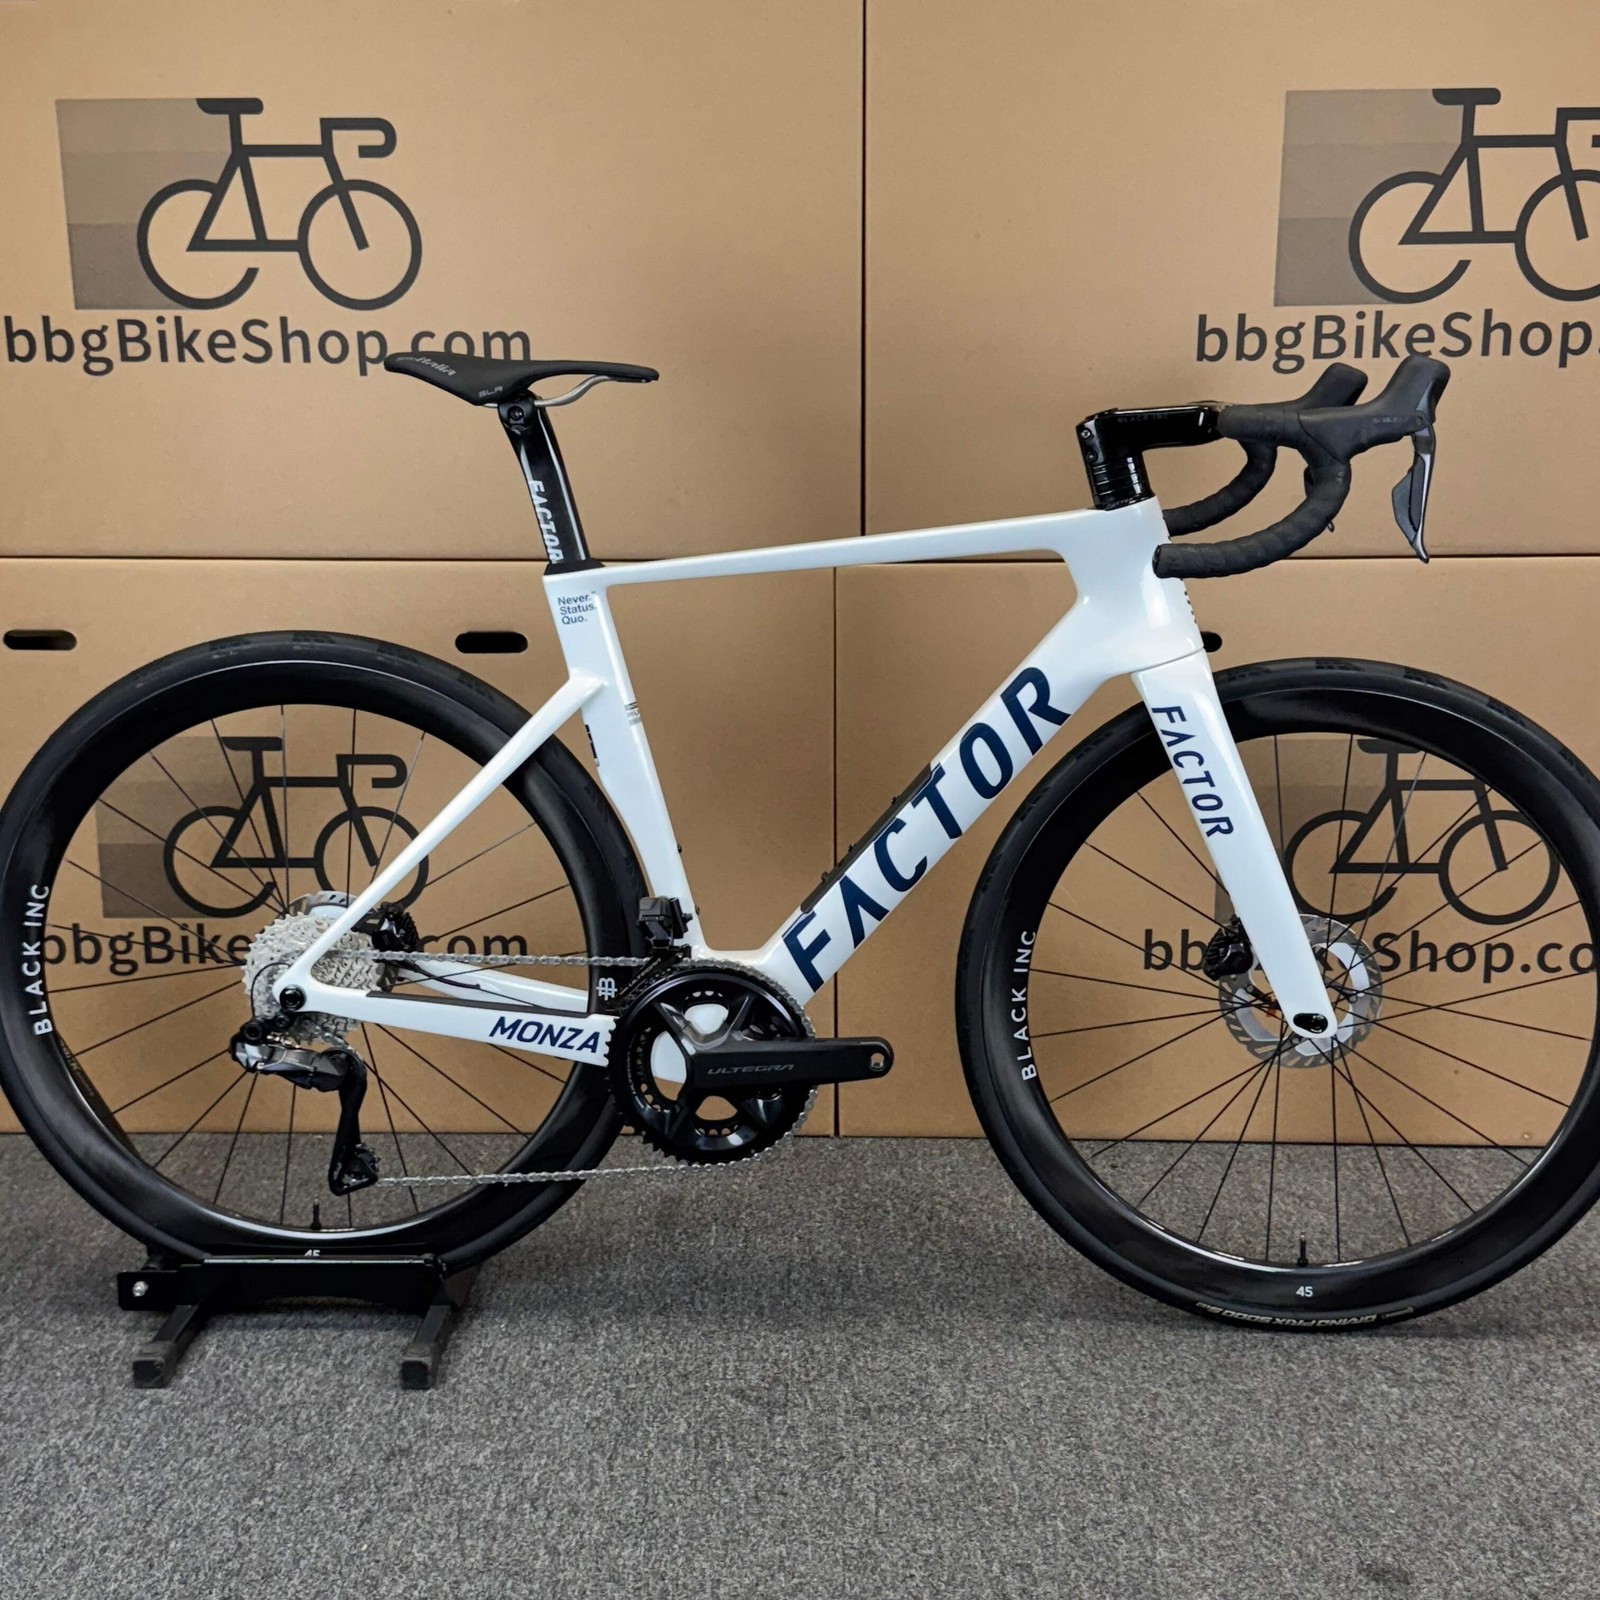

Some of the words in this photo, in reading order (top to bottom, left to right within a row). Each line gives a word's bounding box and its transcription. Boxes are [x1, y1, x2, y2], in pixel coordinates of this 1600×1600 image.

[4, 316, 531, 376] bbgBikeShopcom
[1196, 308, 1600, 374] bbgBikeShop
[478, 386, 503, 398] SLR
[528, 480, 564, 565] FACTOR
[1151, 706, 1234, 837] FACTOR
[781, 667, 1072, 993] FACTOR
[23, 884, 50, 927] INC
[1013, 931, 1037, 973] INC
[21, 941, 54, 1036] BLACK
[488, 1016, 600, 1054] MONZA
[1011, 987, 1037, 1080] BLACK
[707, 1063, 795, 1076] ULTEGRA
[1295, 1286, 1314, 1298] 45
